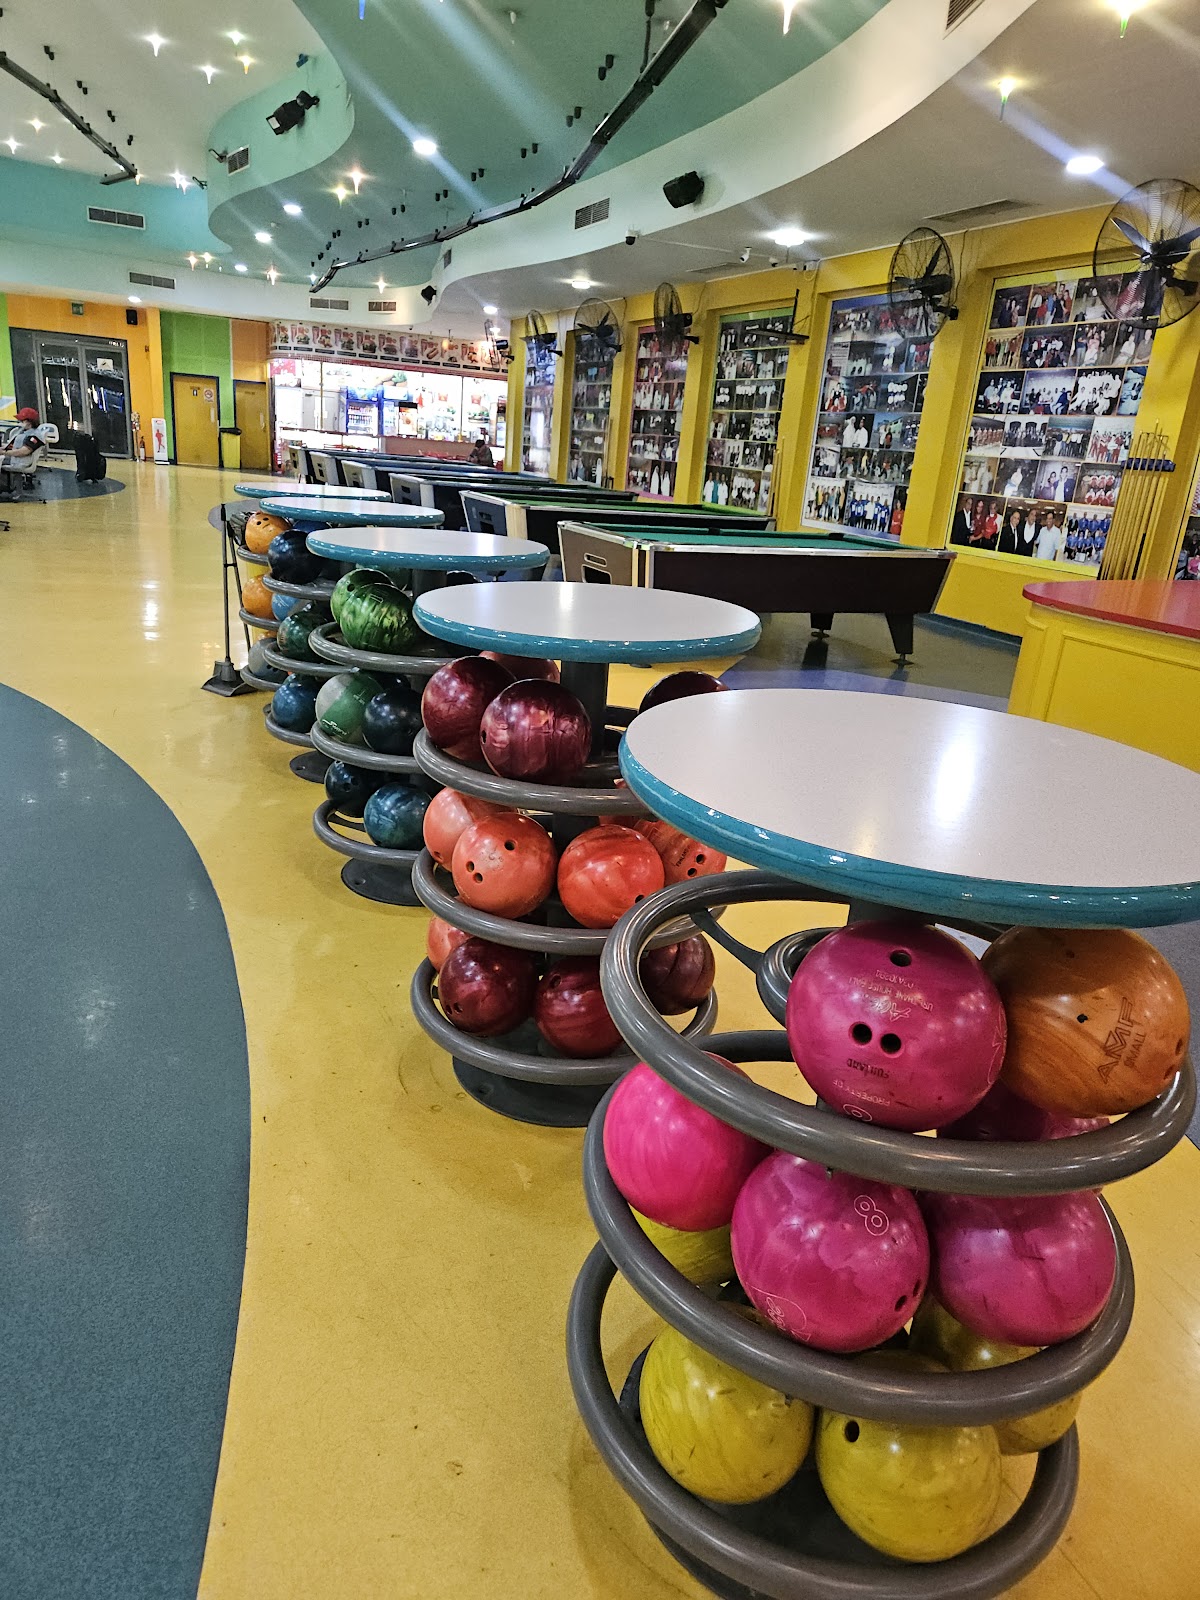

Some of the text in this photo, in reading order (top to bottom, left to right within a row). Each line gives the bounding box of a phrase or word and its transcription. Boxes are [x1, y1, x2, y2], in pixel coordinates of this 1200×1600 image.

[1097, 996, 1134, 1085] AMF
[1123, 1033, 1147, 1069] SMALL
[832, 1079, 891, 1107] PROPERTY OF
[853, 1194, 890, 1237] 8
